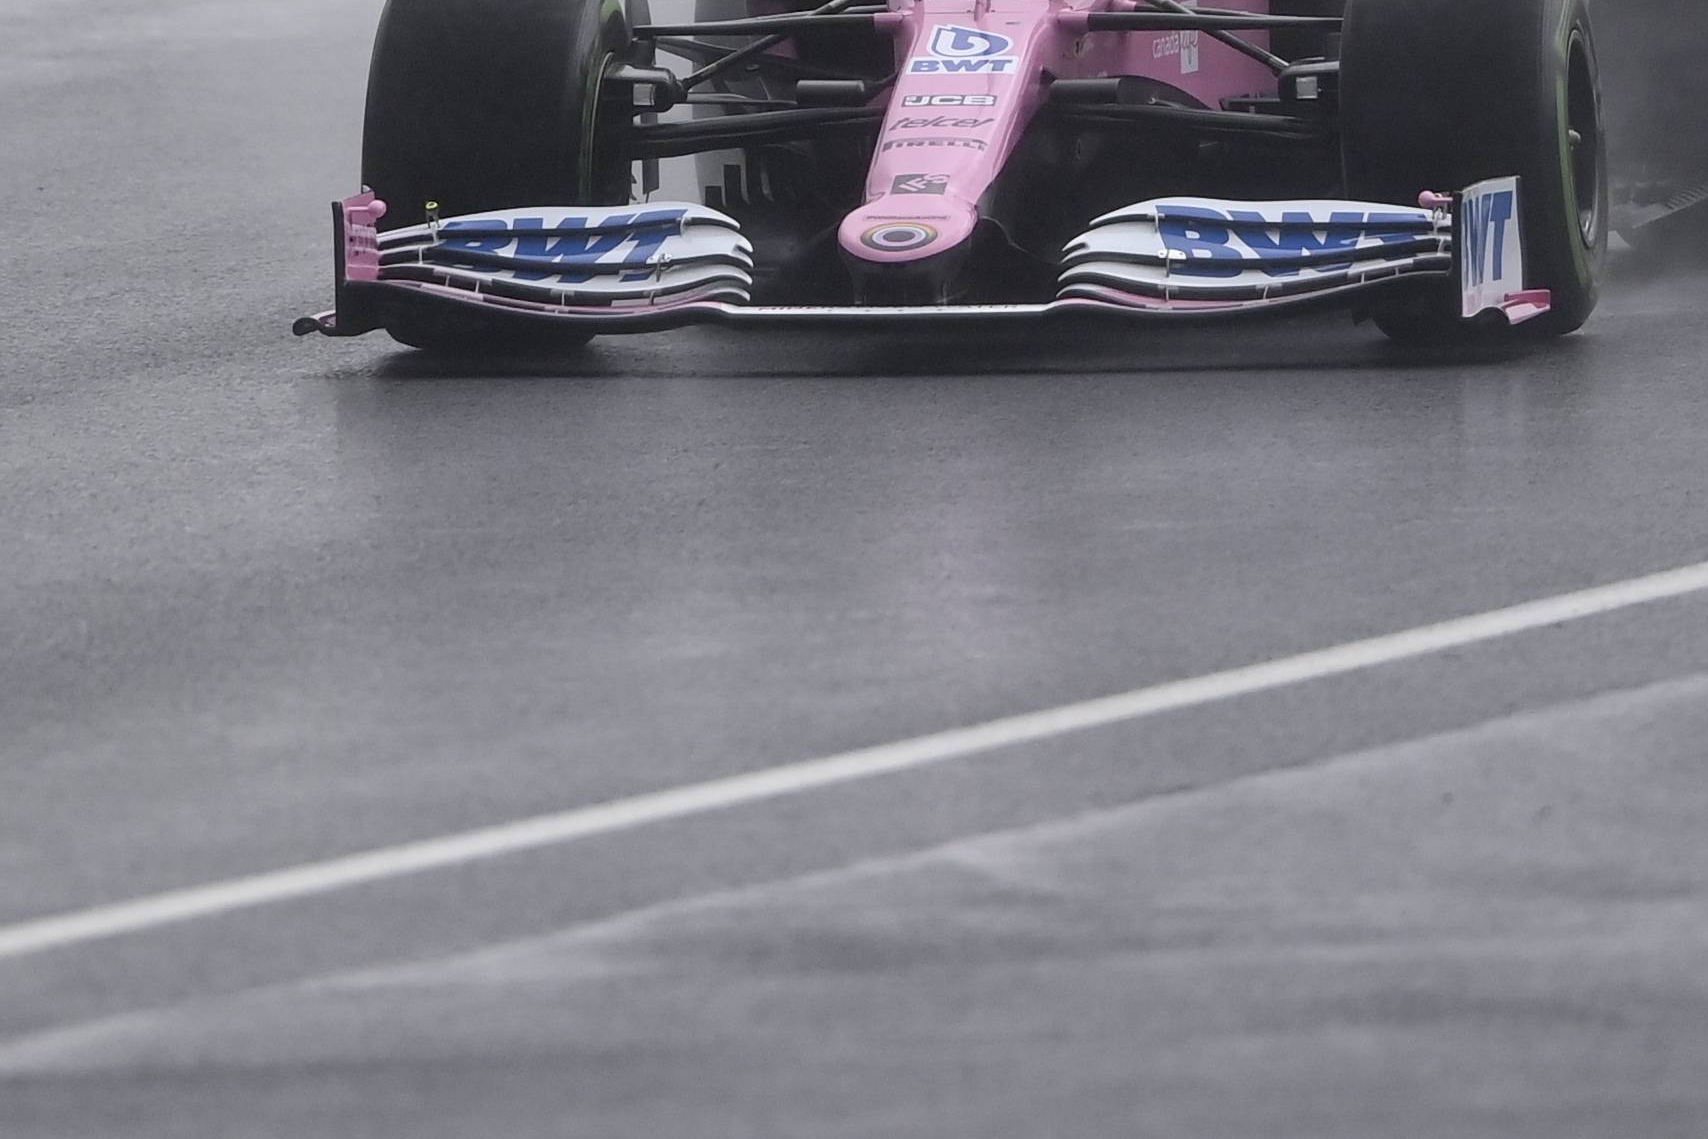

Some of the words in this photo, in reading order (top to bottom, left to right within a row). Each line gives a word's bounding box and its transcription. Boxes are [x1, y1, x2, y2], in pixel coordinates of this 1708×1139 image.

[911, 59, 1014, 73] BWT
[904, 95, 996, 107] JCB
[888, 115, 995, 132] telcel
[439, 208, 688, 284] BWT
[1155, 205, 1430, 278] BWT
